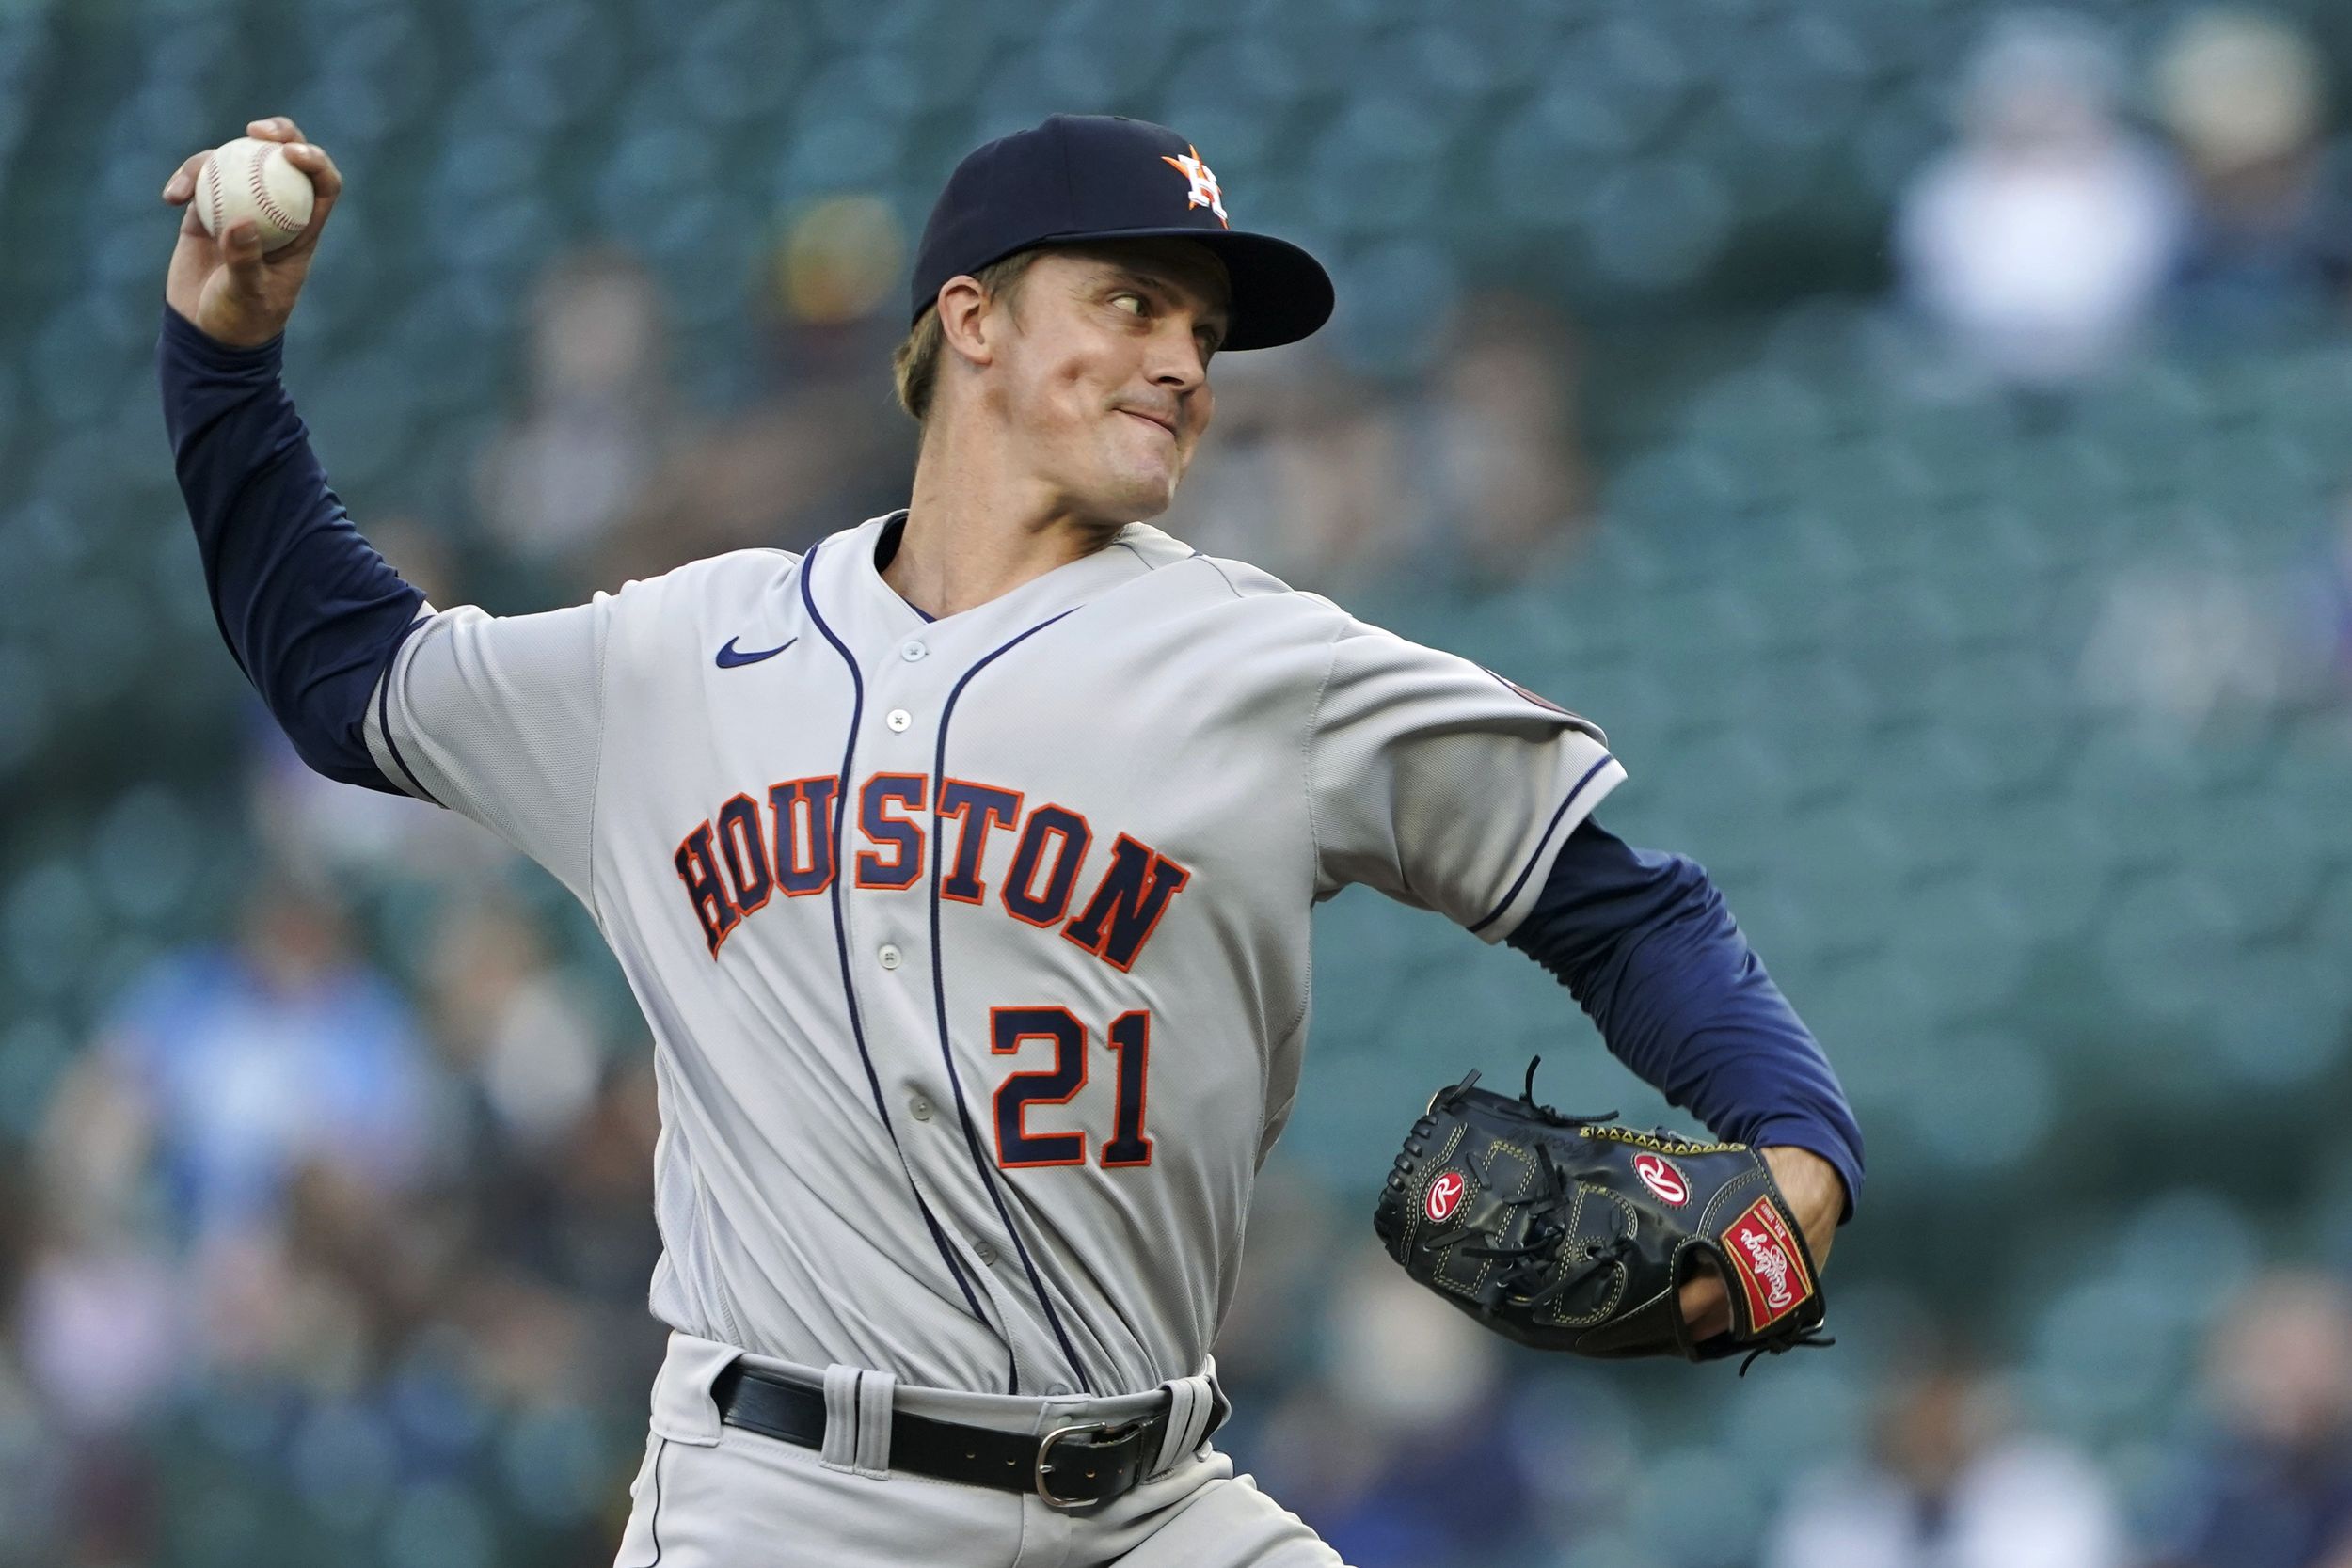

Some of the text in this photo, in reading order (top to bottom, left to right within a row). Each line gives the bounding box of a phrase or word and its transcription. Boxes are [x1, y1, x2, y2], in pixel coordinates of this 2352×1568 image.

[674, 771, 1191, 973] HOUSTON
[989, 1005, 1152, 1168] 21
[1740, 1228, 1792, 1308] Rawlings
